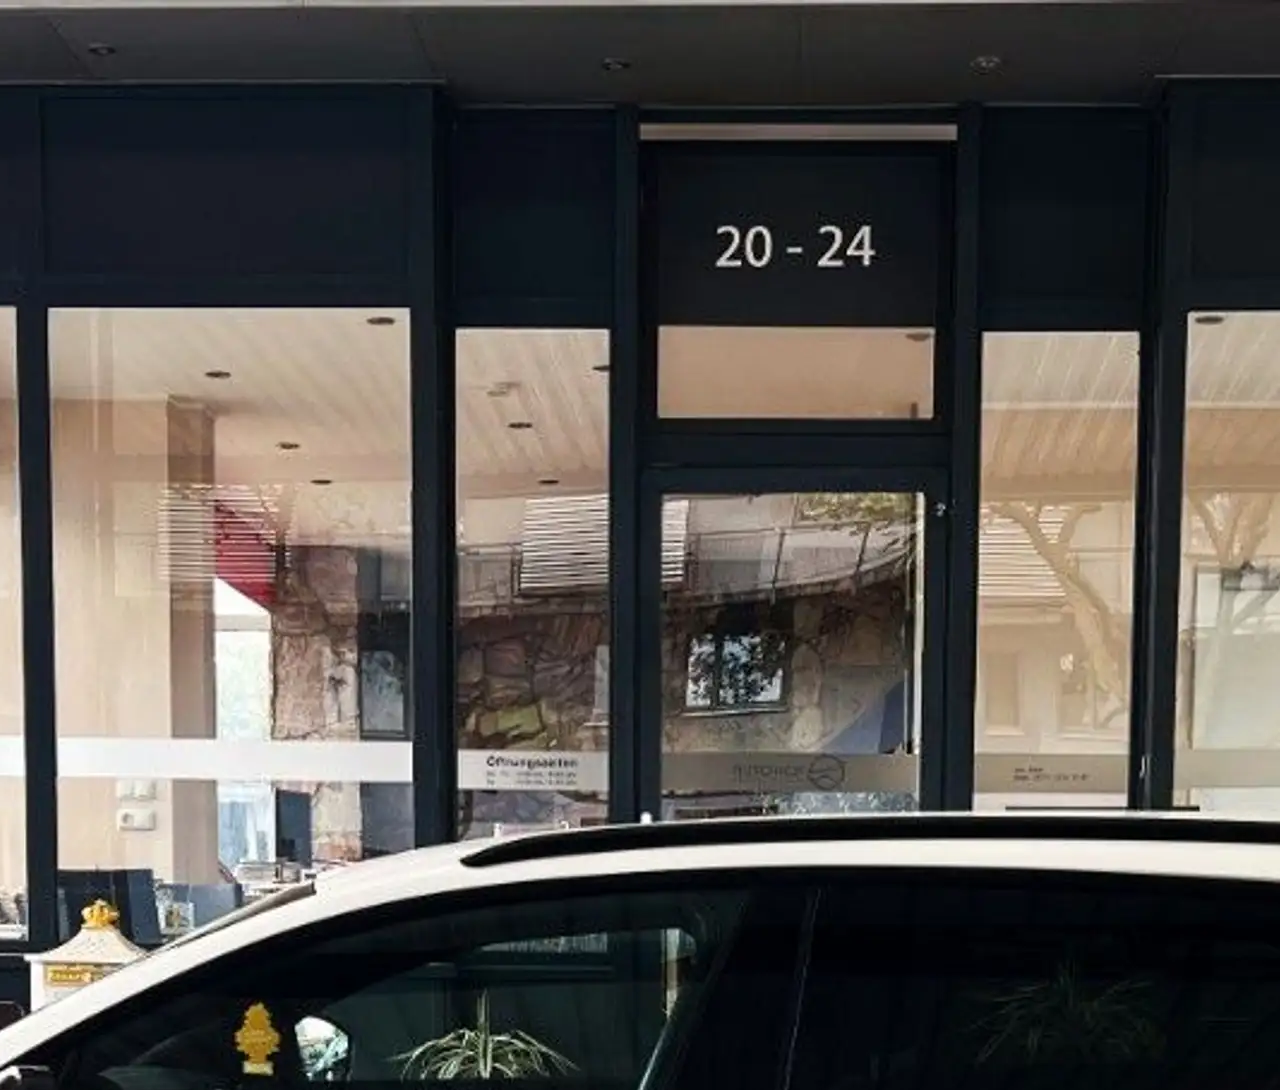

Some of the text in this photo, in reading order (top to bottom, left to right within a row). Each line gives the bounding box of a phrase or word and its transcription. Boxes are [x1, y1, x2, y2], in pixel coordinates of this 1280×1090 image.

[715, 224, 876, 268] 20 - 24
